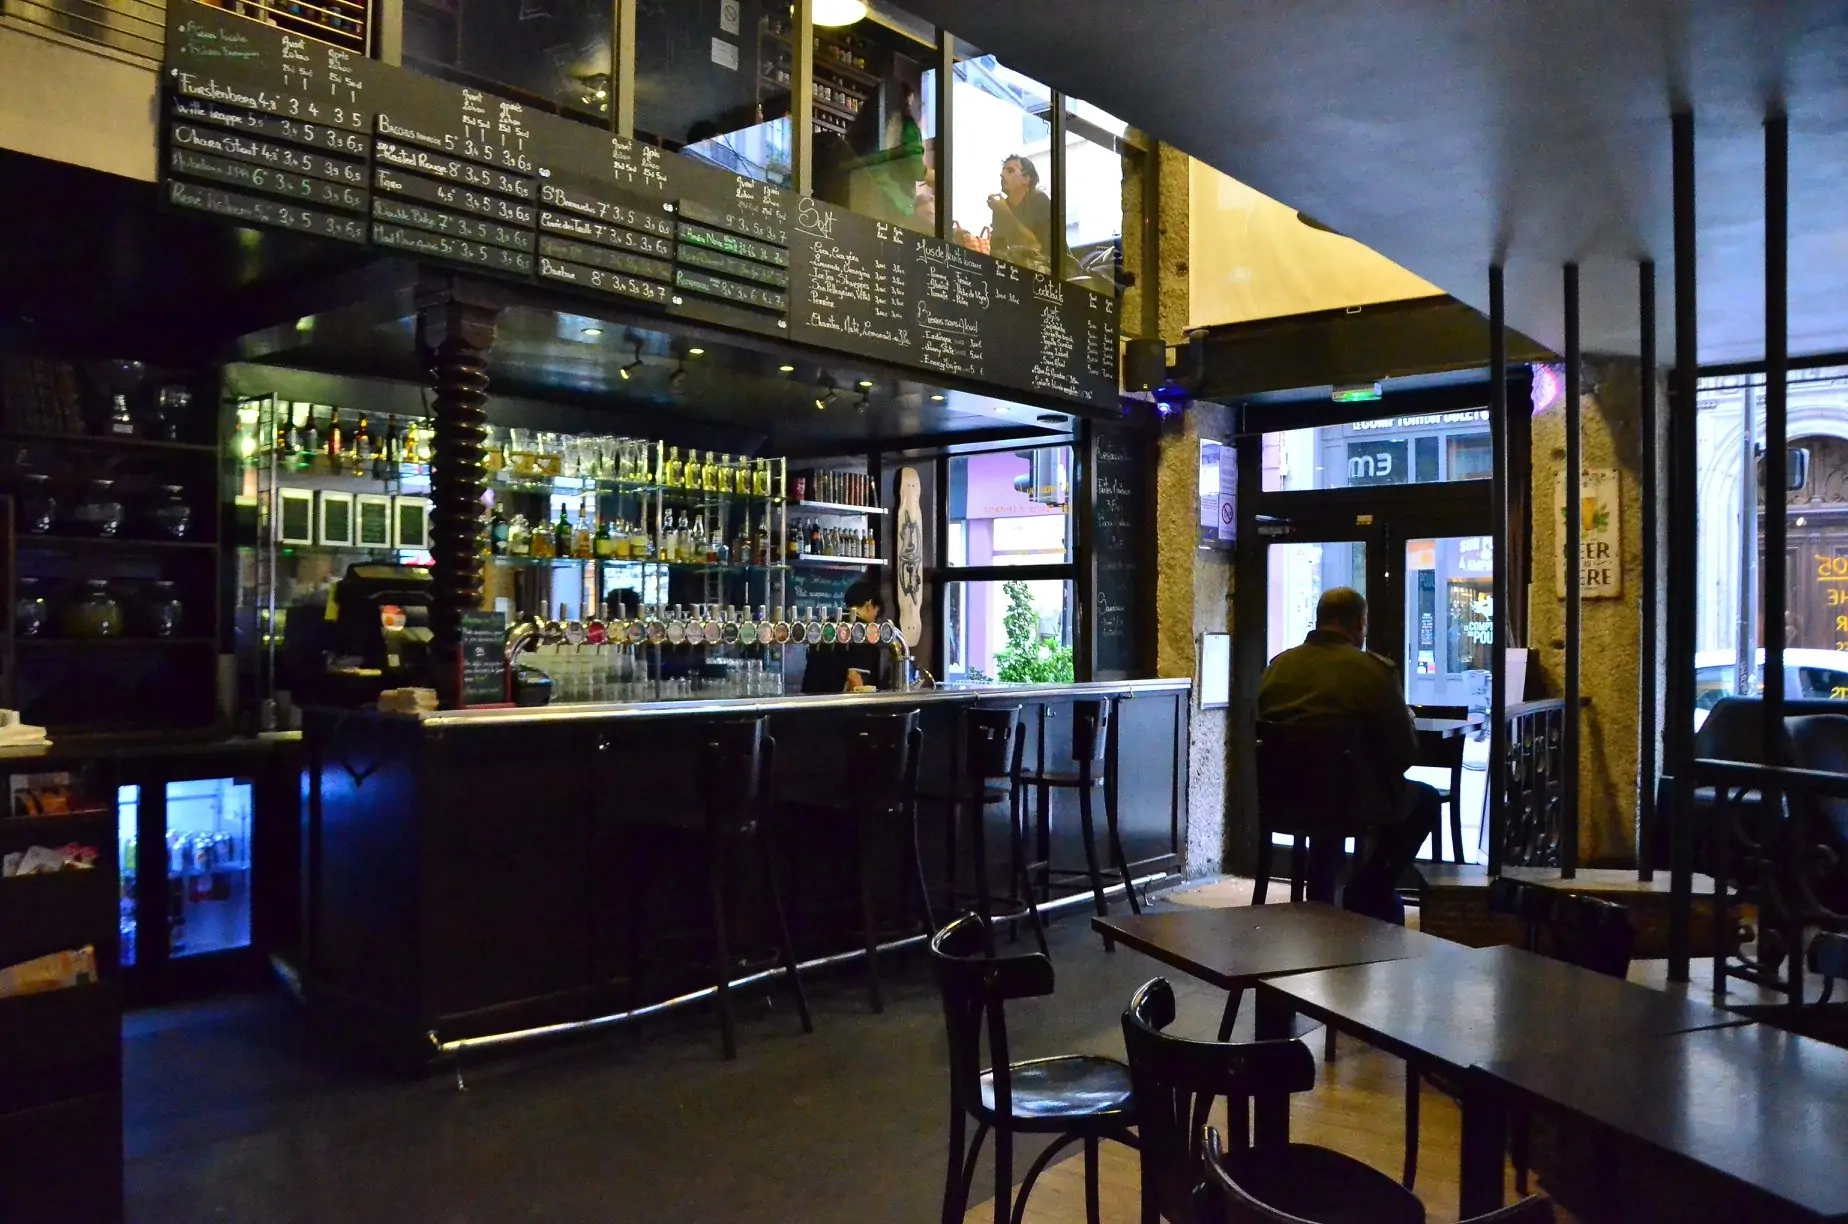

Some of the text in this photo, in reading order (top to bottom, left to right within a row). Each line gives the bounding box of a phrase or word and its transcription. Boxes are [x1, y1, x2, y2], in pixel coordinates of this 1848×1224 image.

[289, 98, 299, 115] 3
[308, 102, 320, 117] 4
[334, 108, 344, 123] 3
[352, 112, 362, 127] 5
[304, 124, 316, 141] 5
[484, 145, 493, 160] 5
[302, 155, 312, 171] 5
[482, 170, 491, 185] 5
[301, 179, 312, 196] 5
[483, 197, 491, 212] 5
[515, 206, 530, 221] 6,5
[301, 212, 312, 228] 5
[628, 211, 635, 224] 5
[799, 198, 837, 238] Soft
[478, 223, 486, 237] 5
[779, 231, 788, 244] 7
[626, 233, 633, 246] 5
[479, 246, 488, 261] 5
[916, 239, 934, 264] Jus
[935, 246, 944, 257] de
[657, 287, 666, 301] 7
[1033, 274, 1063, 302] Cocktails
